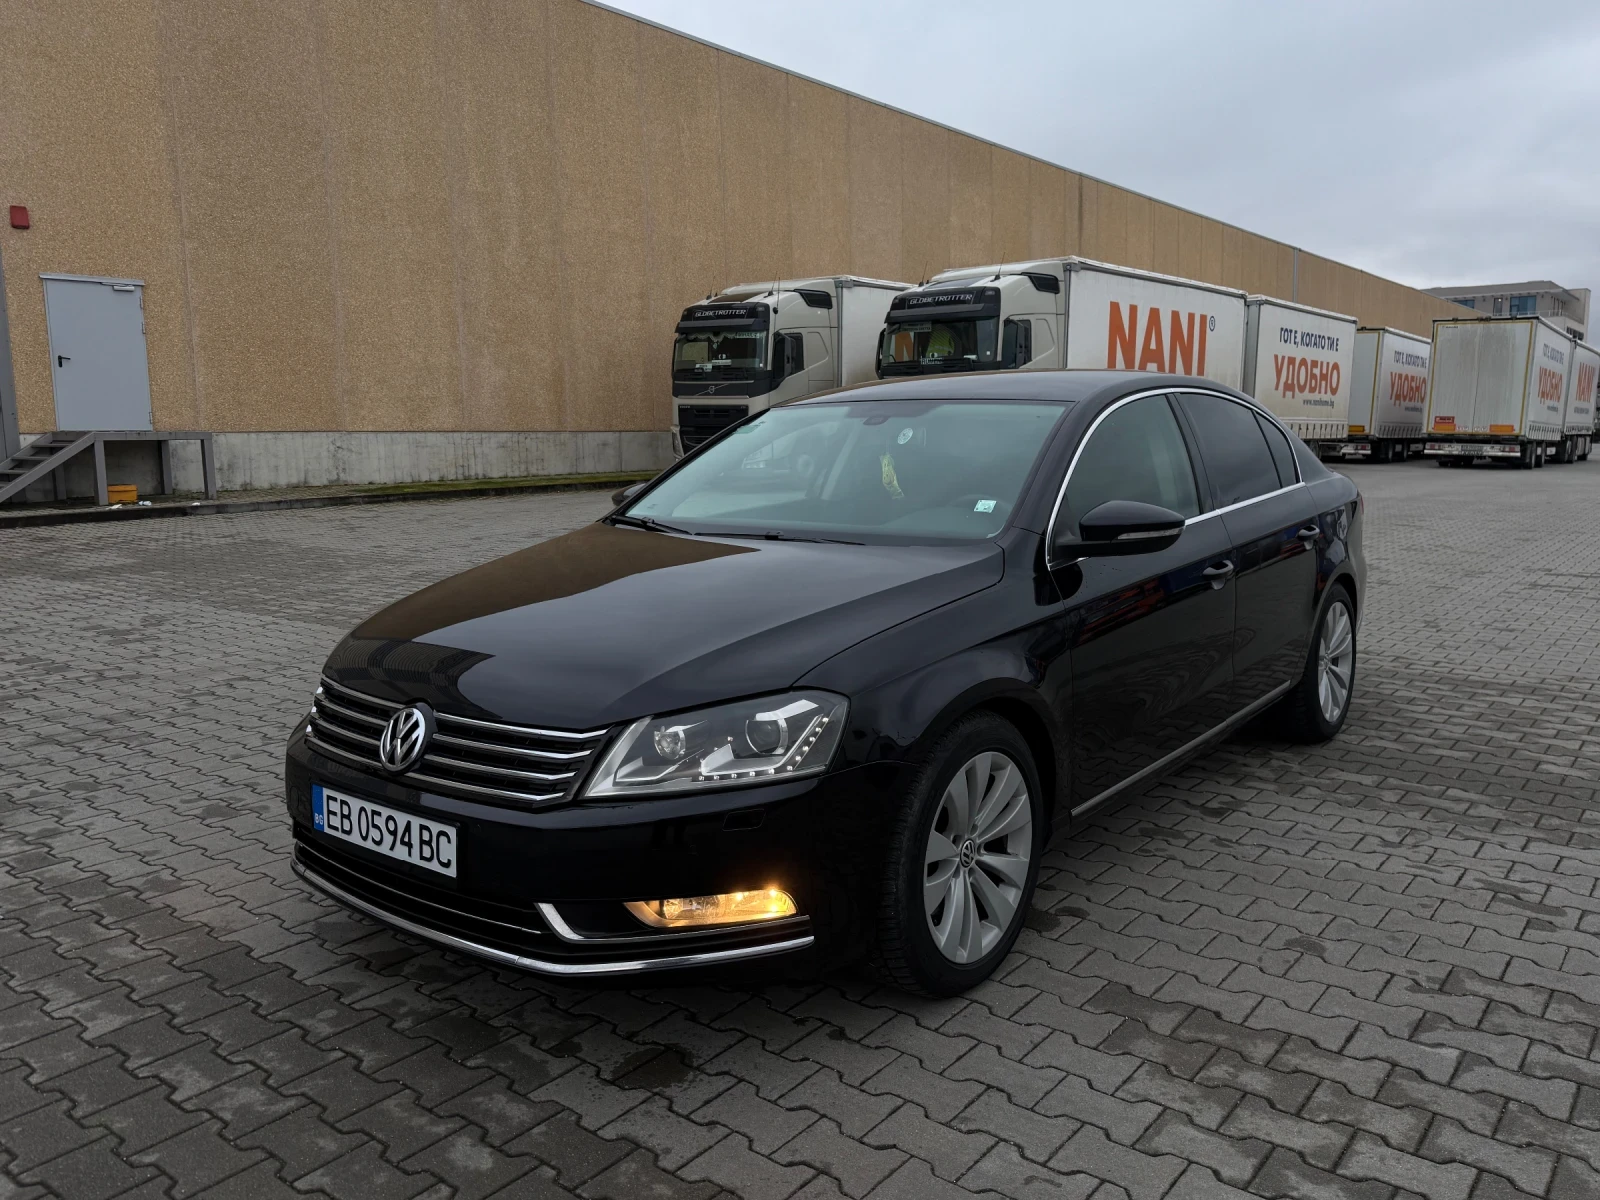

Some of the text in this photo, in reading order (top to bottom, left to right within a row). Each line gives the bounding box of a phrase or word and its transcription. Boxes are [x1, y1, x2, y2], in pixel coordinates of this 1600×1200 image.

[909, 294, 973, 305] GLOBETROTTER
[695, 309, 746, 317] GLOBETROTTER
[1300, 331, 1326, 350] КОГАТО
[1273, 353, 1341, 399] УДОБНО
[1389, 371, 1427, 407] УДОБНО
[314, 812, 324, 826] BG
